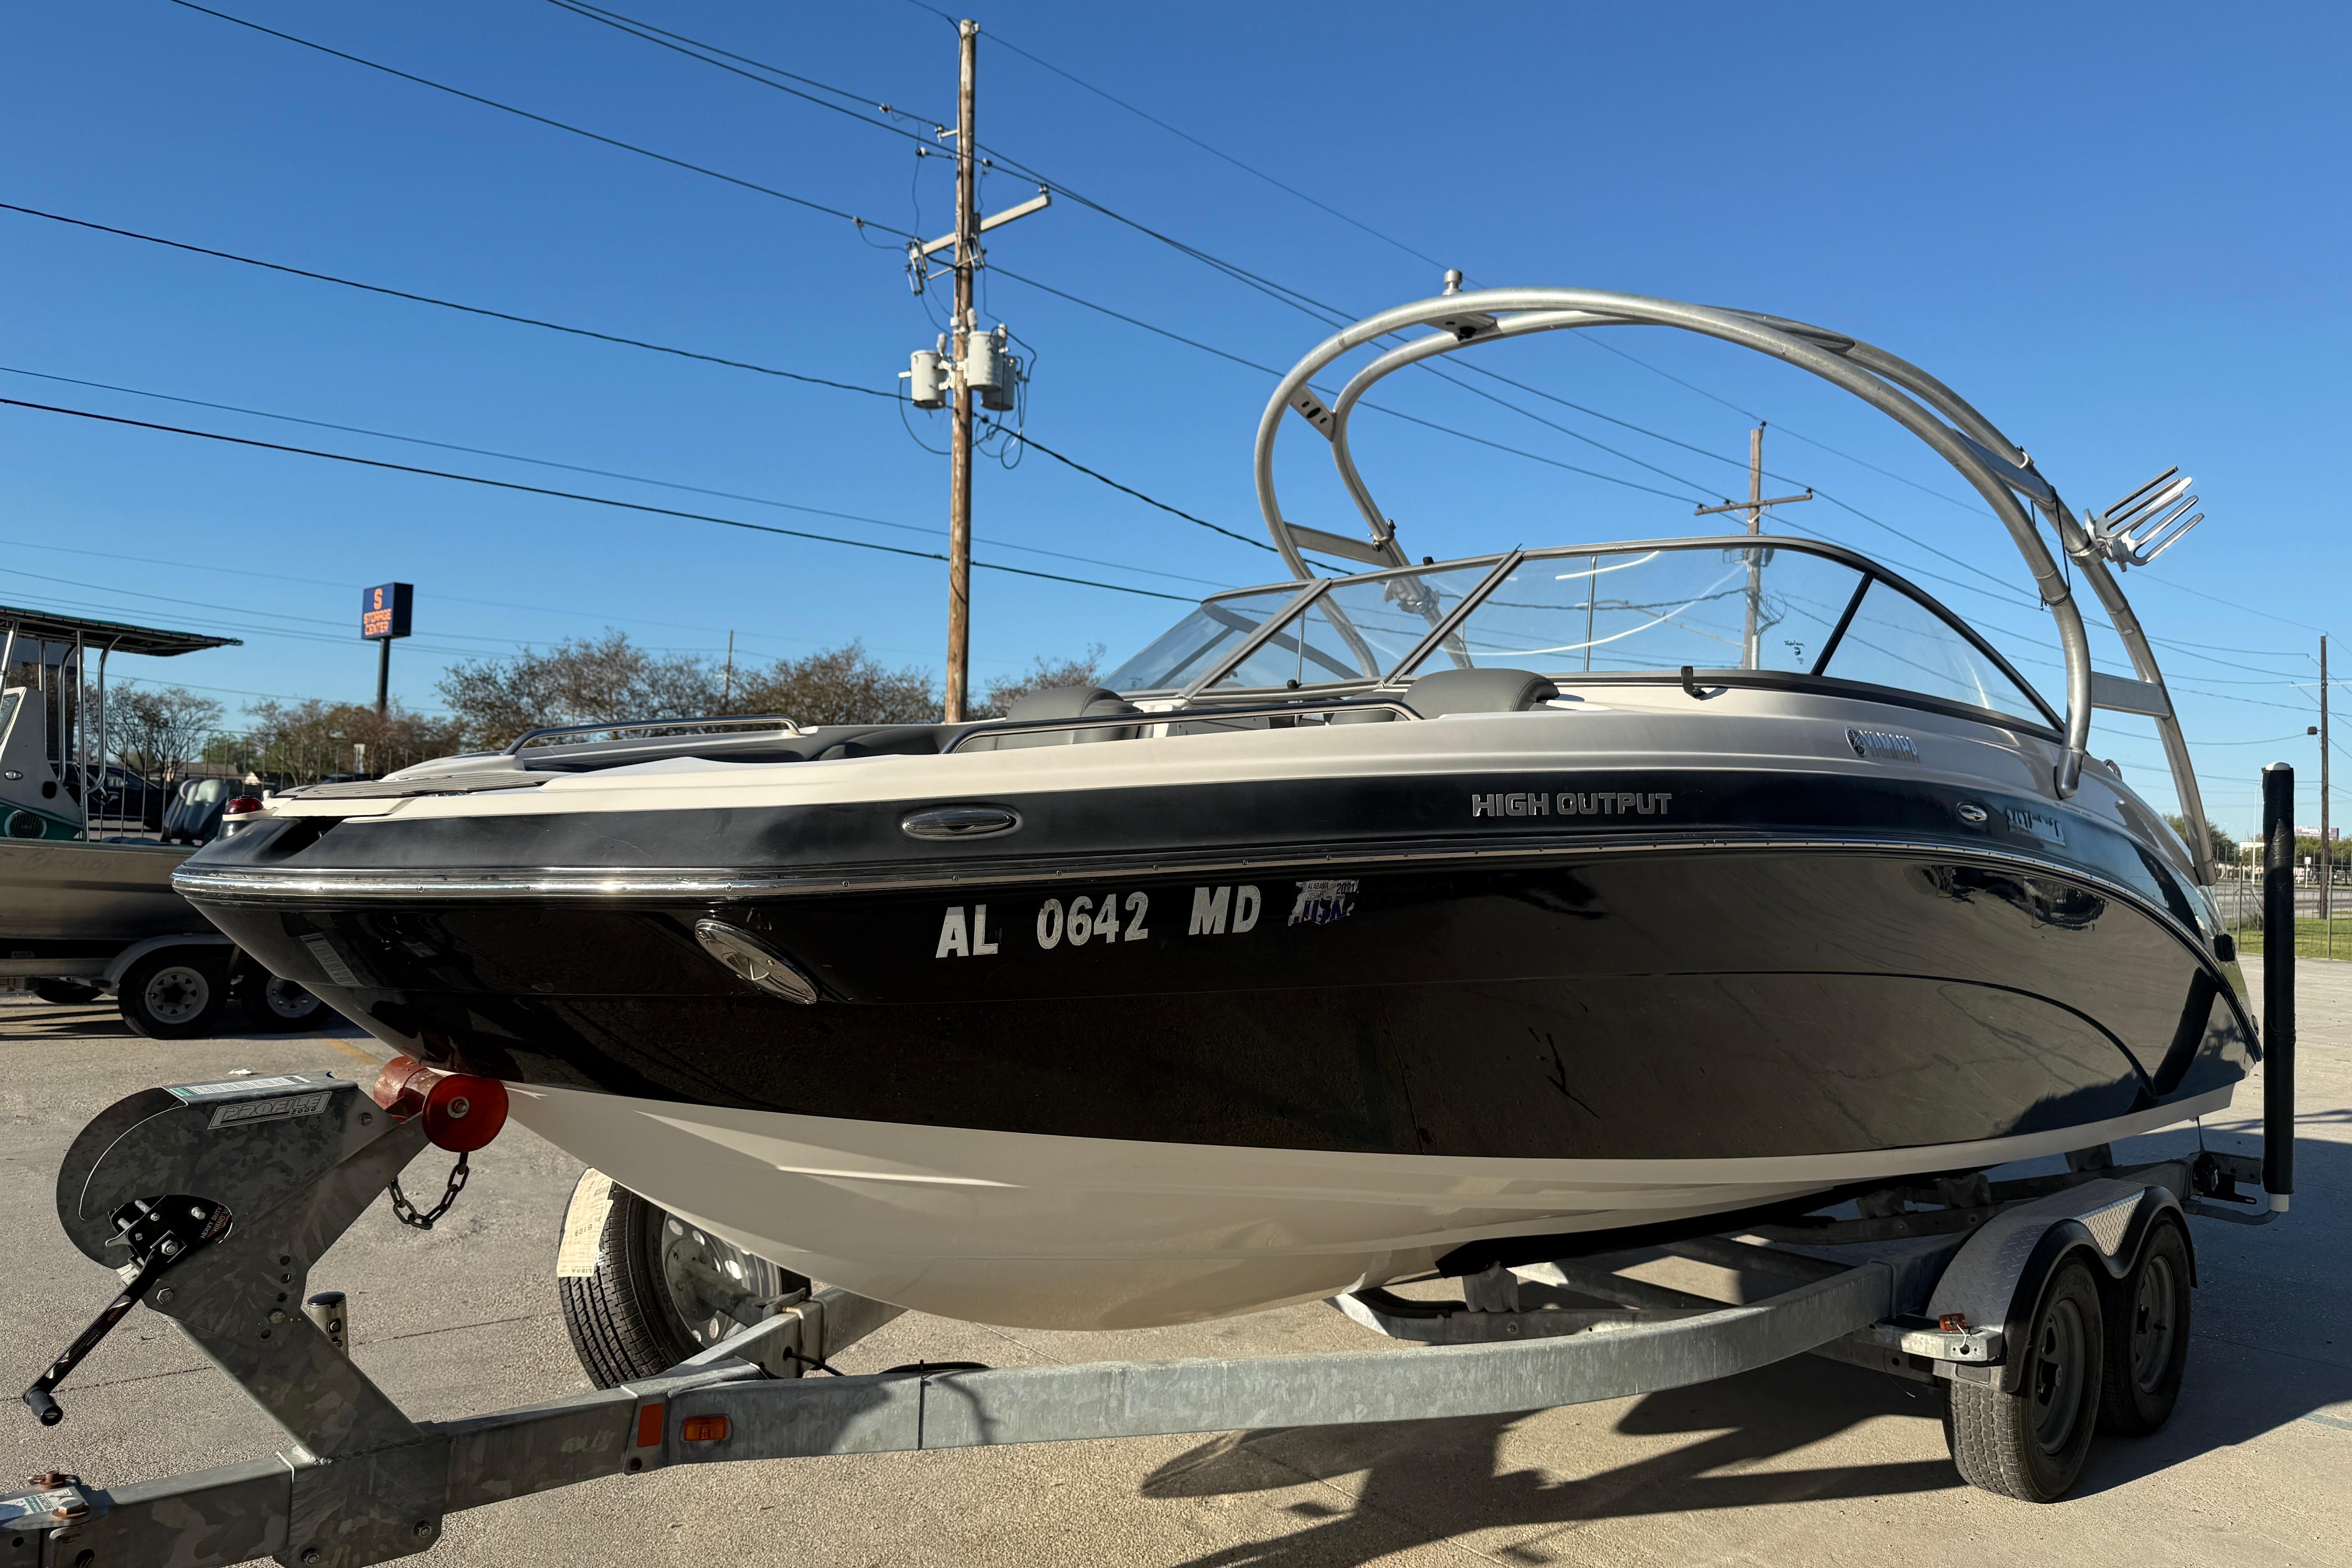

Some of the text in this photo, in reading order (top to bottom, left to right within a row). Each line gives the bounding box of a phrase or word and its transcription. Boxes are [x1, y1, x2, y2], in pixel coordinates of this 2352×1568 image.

[374, 588, 383, 610] S
[1858, 729, 1918, 756] YAMAHA
[1472, 793, 1672, 817] HIGH OUTPUT
[936, 885, 1261, 958] AL 0642 MD
[222, 1095, 322, 1120] PROFILE
[200, 1206, 222, 1238] HEAVY DUTY
[213, 1216, 226, 1232] HAND
